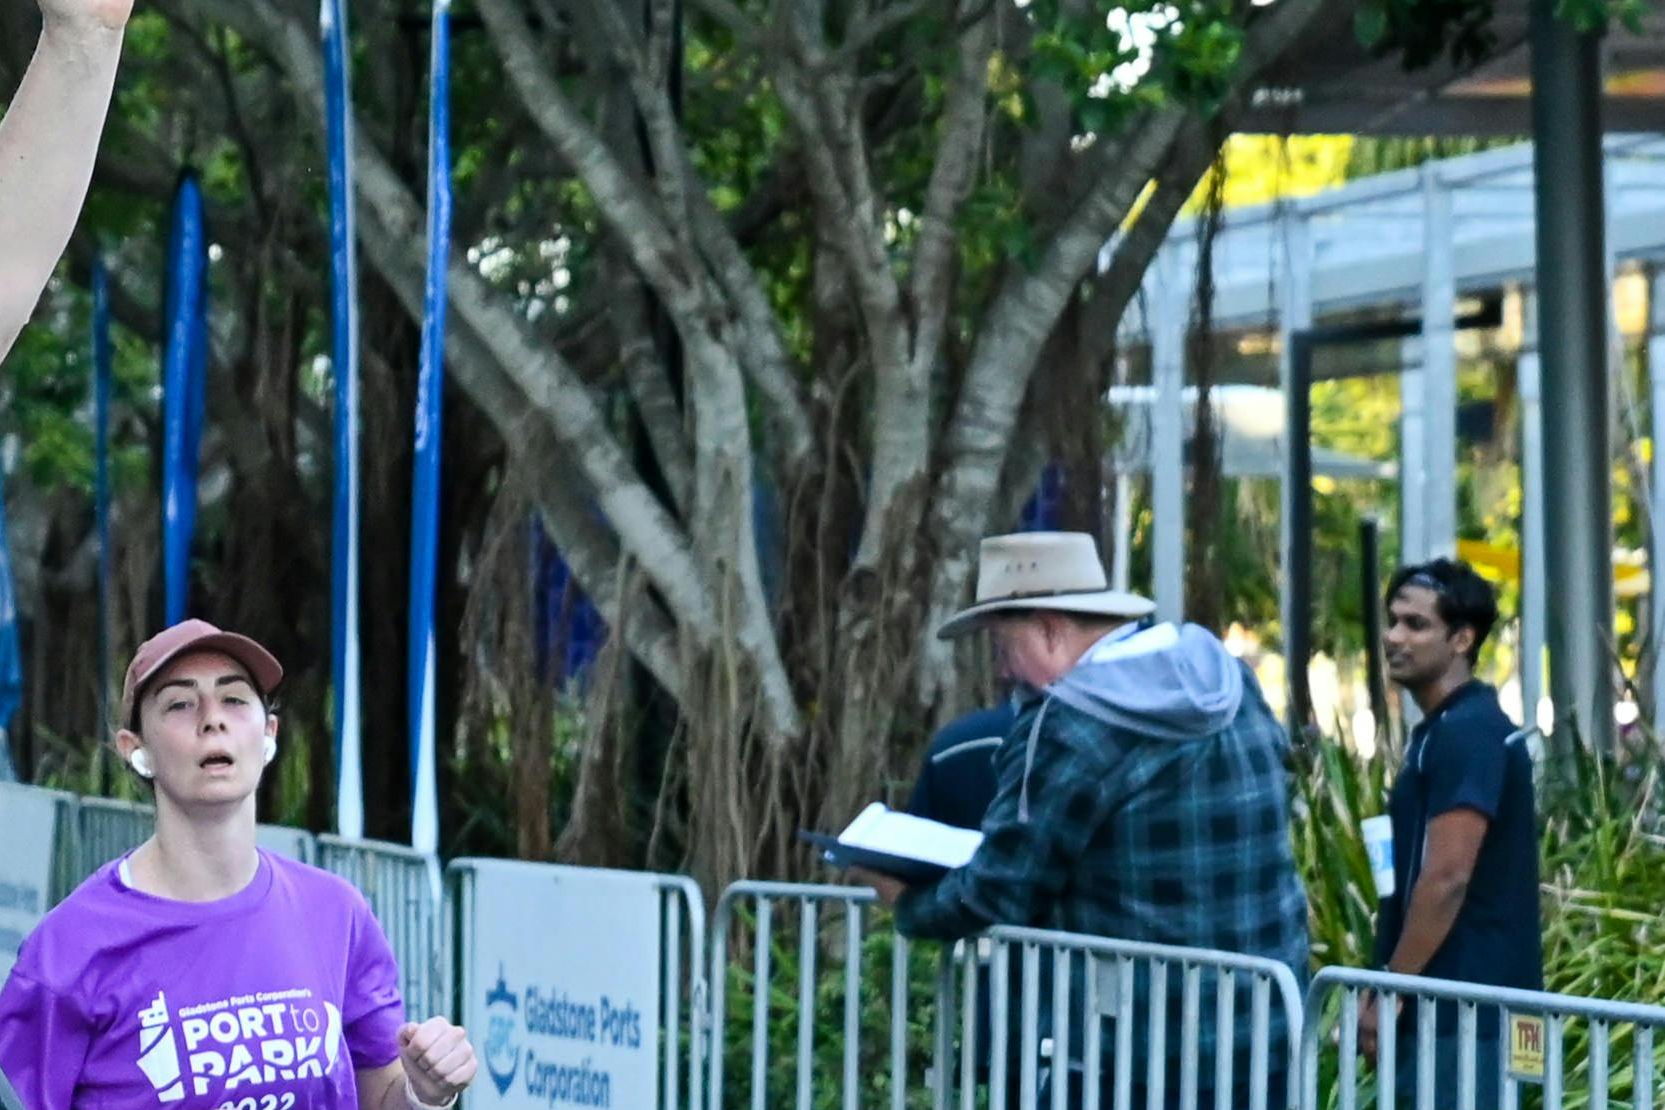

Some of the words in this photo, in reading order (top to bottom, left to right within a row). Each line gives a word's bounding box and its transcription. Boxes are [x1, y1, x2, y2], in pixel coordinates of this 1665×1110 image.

[182, 1003, 286, 1051] PORT
[290, 1003, 320, 1032] to
[524, 986, 596, 1042] Gladstone
[600, 995, 641, 1049] Ports
[189, 1036, 323, 1095] PARK
[524, 1048, 610, 1110] Corporation
